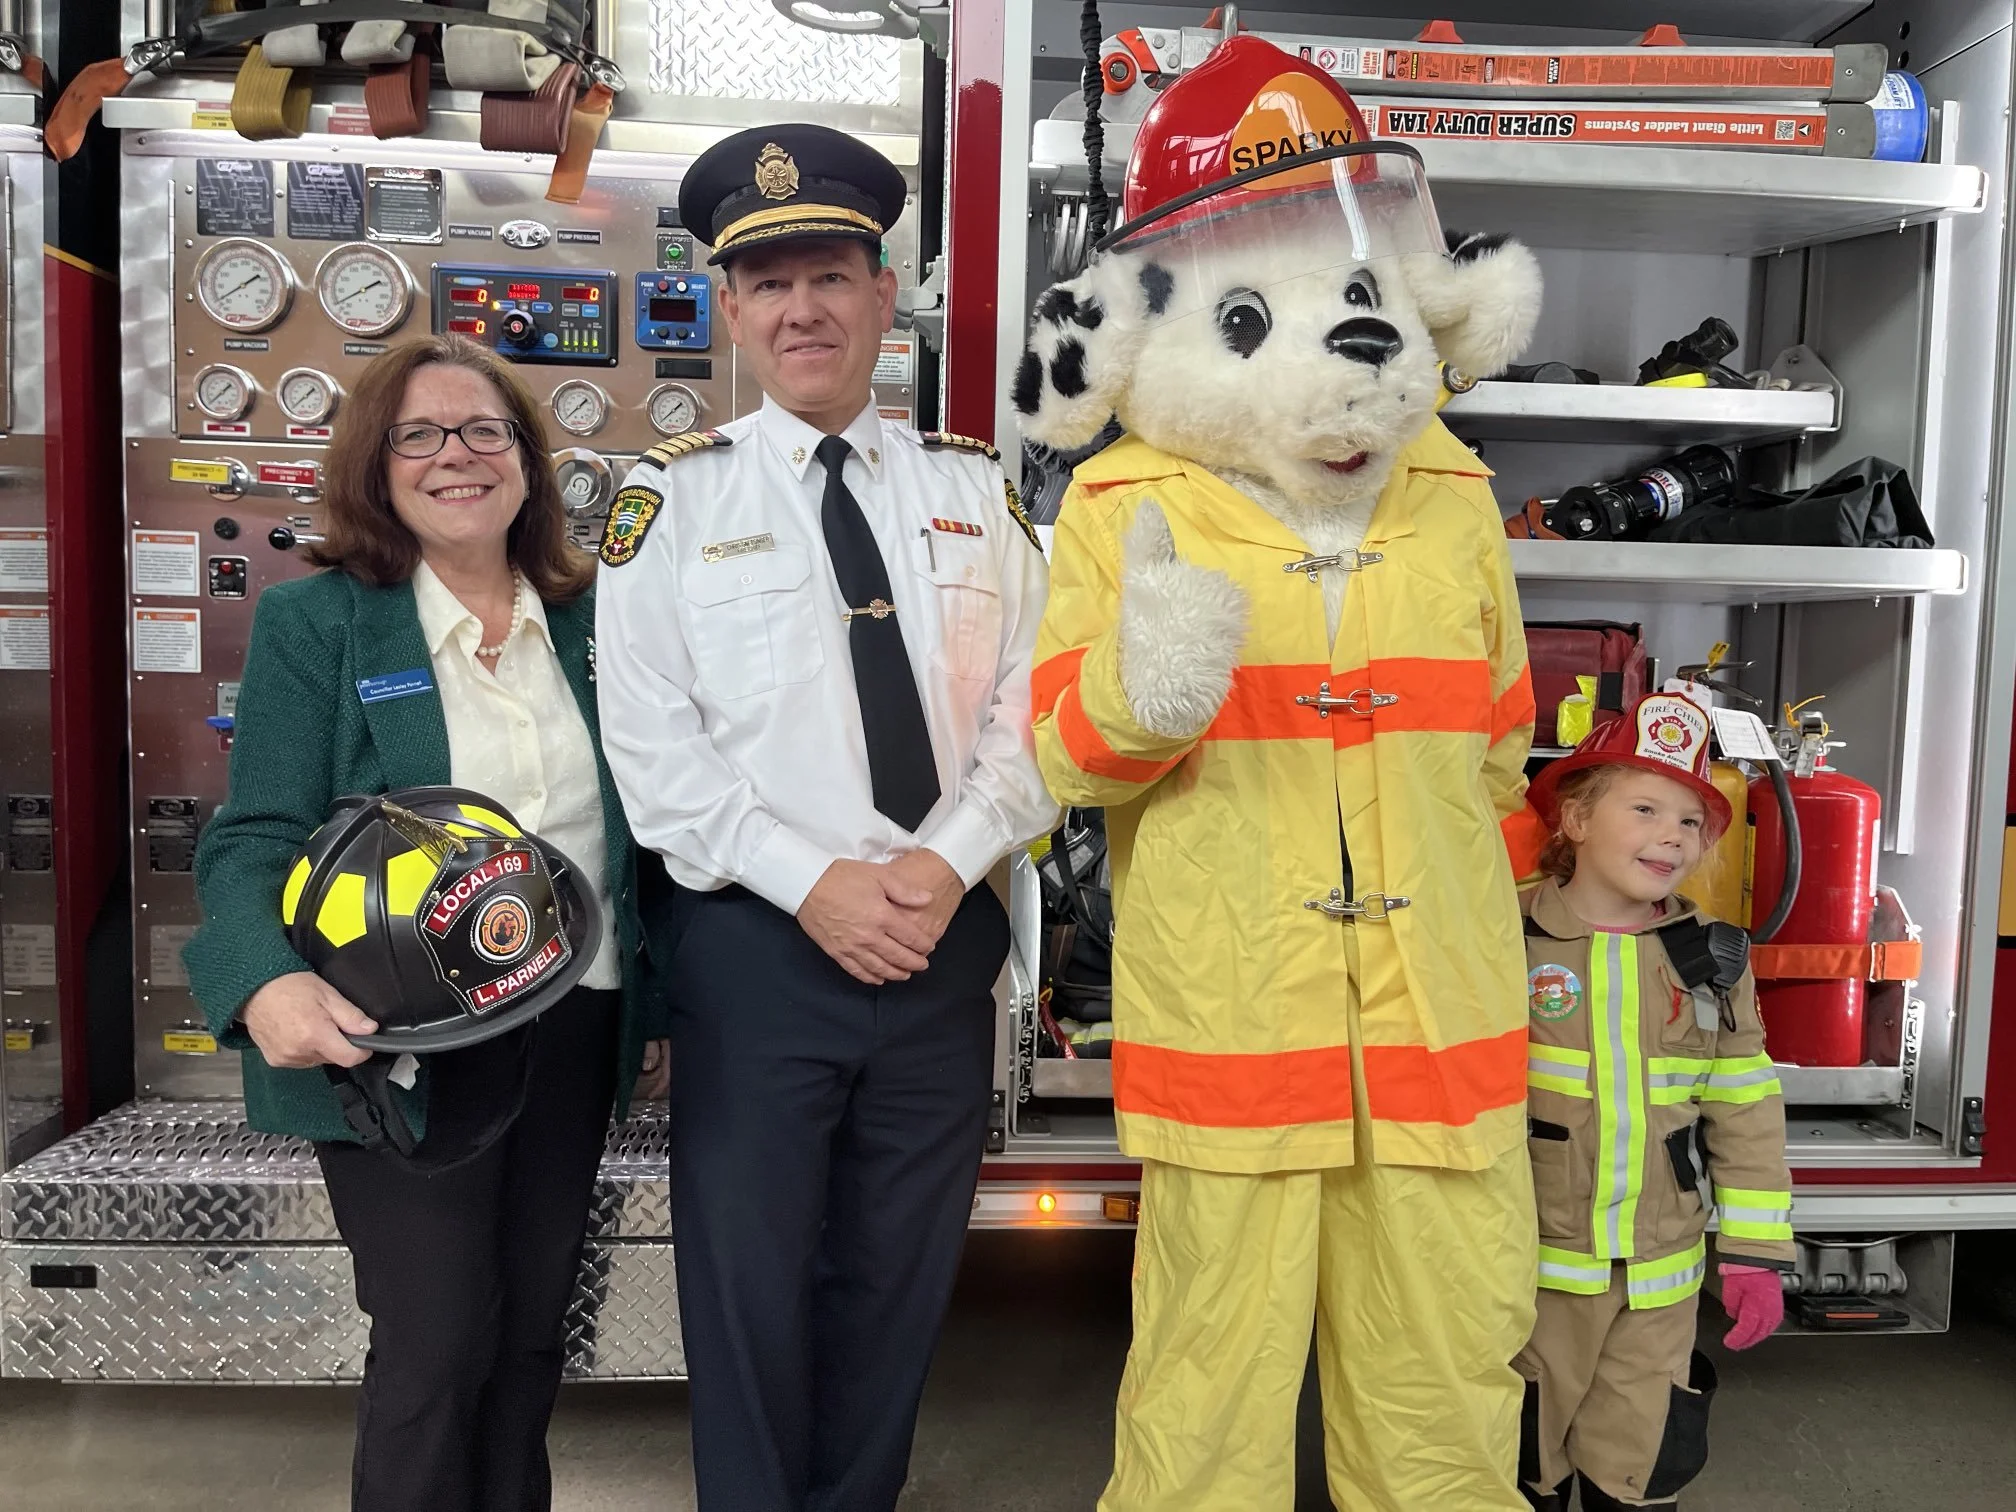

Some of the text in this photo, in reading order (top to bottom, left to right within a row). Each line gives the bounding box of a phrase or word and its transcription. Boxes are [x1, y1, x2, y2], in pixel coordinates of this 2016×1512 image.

[1362, 52, 1370, 74] Little
[1434, 112, 1493, 136] DUTY
[1498, 114, 1576, 137] SUPER
[1584, 120, 1764, 134] Little Giant Ladder Systems
[478, 289, 487, 302] 0
[590, 288, 599, 300] 0
[476, 321, 485, 334] 0
[265, 468, 303, 476] PRECONNECT
[618, 489, 661, 505] PETERBOROUGH
[1667, 700, 1688, 710] Junior
[1643, 706, 1703, 732] FIRE CHIEF
[1657, 742, 1680, 752] RESCUE
[1644, 748, 1687, 765] Smoke Alarms
[433, 856, 522, 924] LOCAL 169
[478, 943, 558, 1004] L. PARNELL
